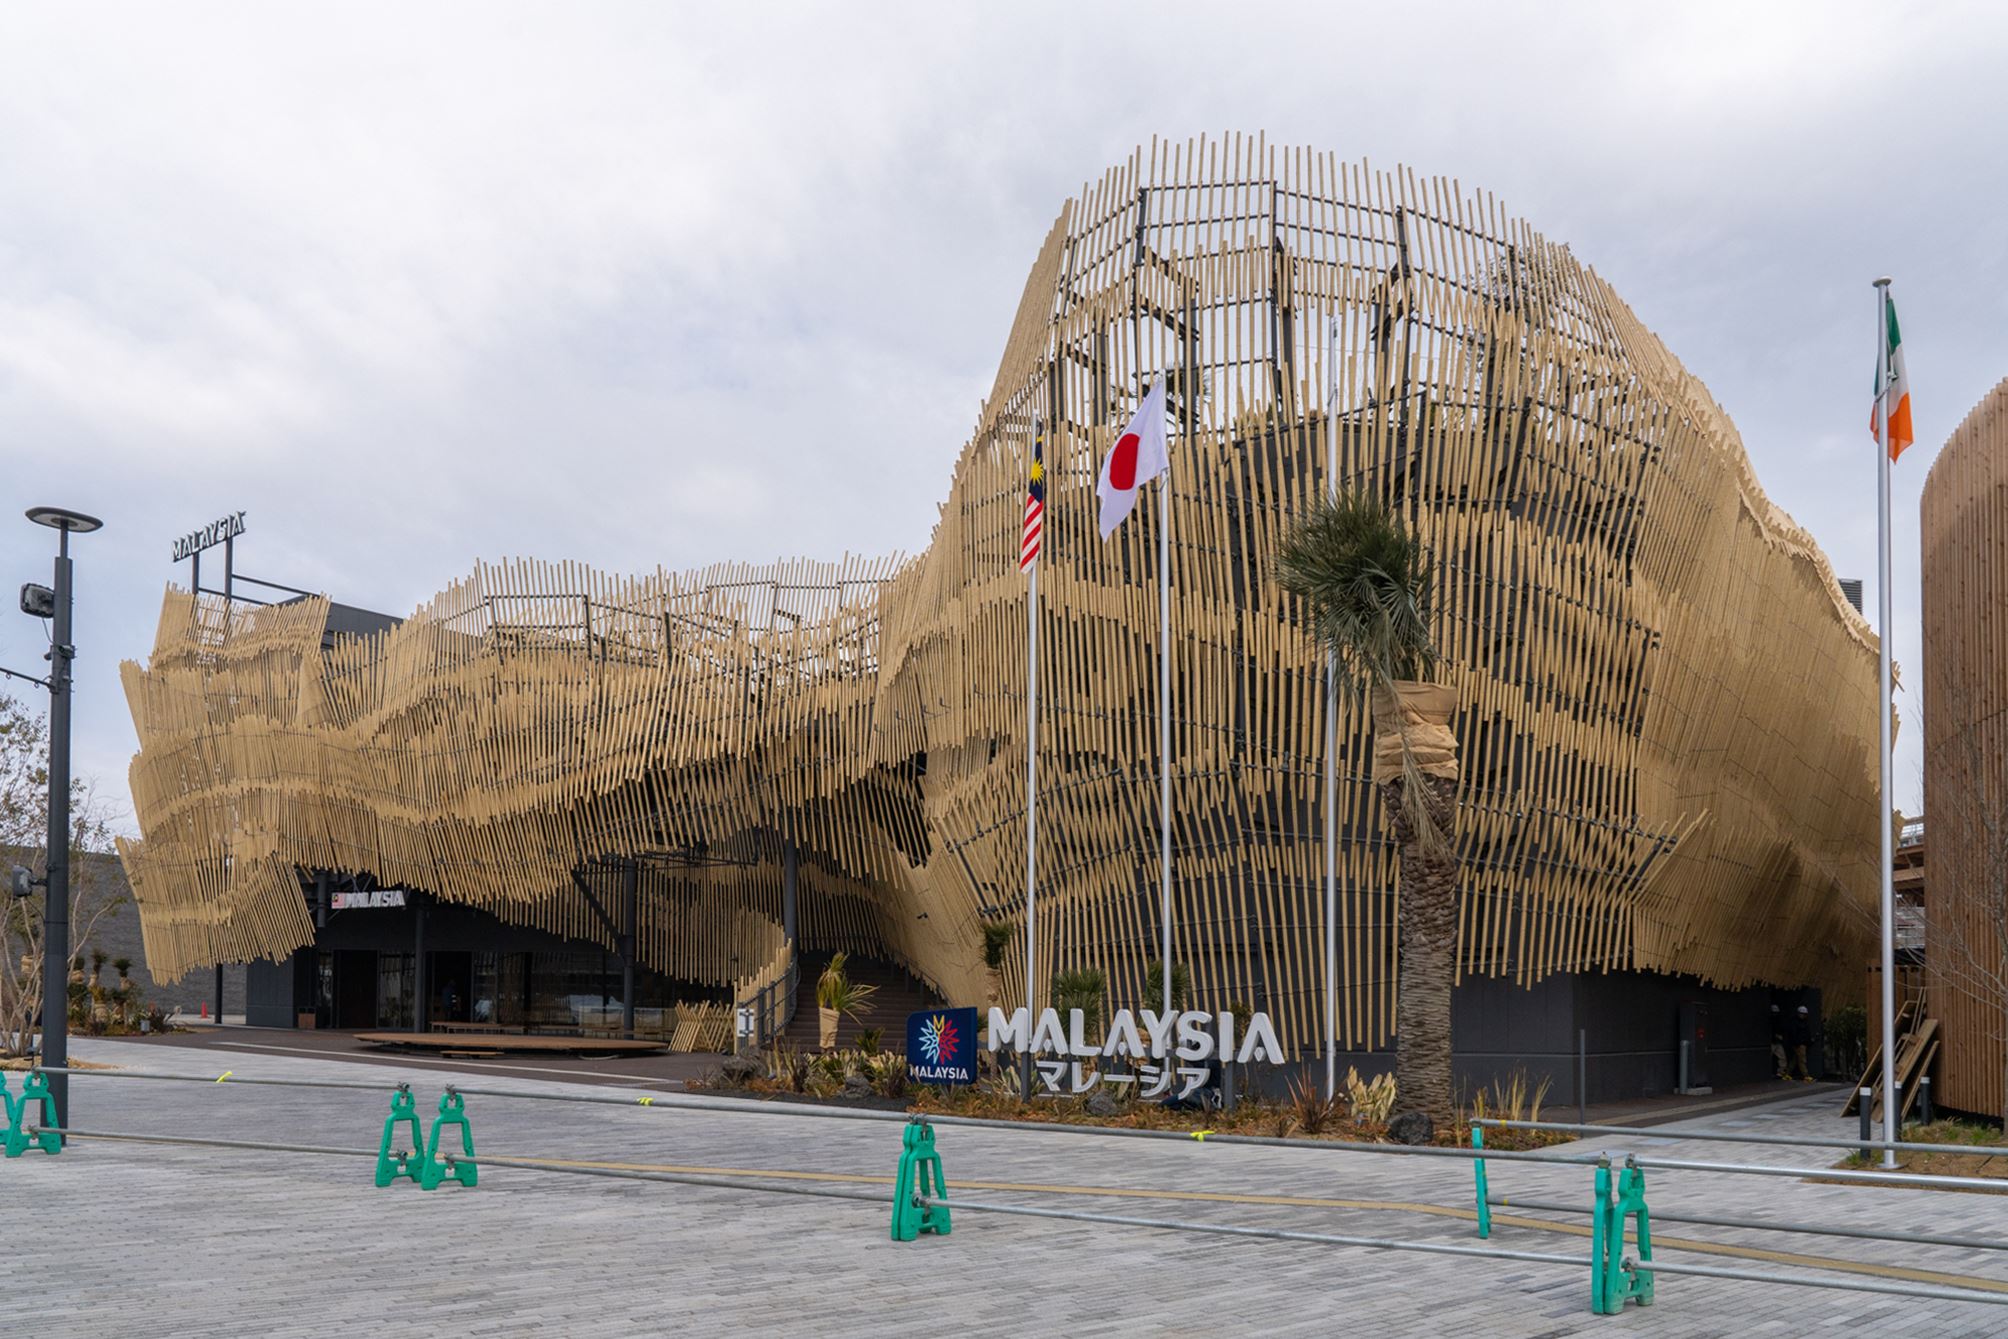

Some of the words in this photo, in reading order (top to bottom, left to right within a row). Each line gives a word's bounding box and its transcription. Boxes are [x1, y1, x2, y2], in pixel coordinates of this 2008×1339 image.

[172, 511, 246, 562] MALAYSIA
[344, 889, 406, 908] MALAYSIA
[988, 1007, 1285, 1064] MALAYSIA
[910, 1065, 968, 1080] MALAYSIA
[1037, 1061, 1211, 1100] マレーシア
